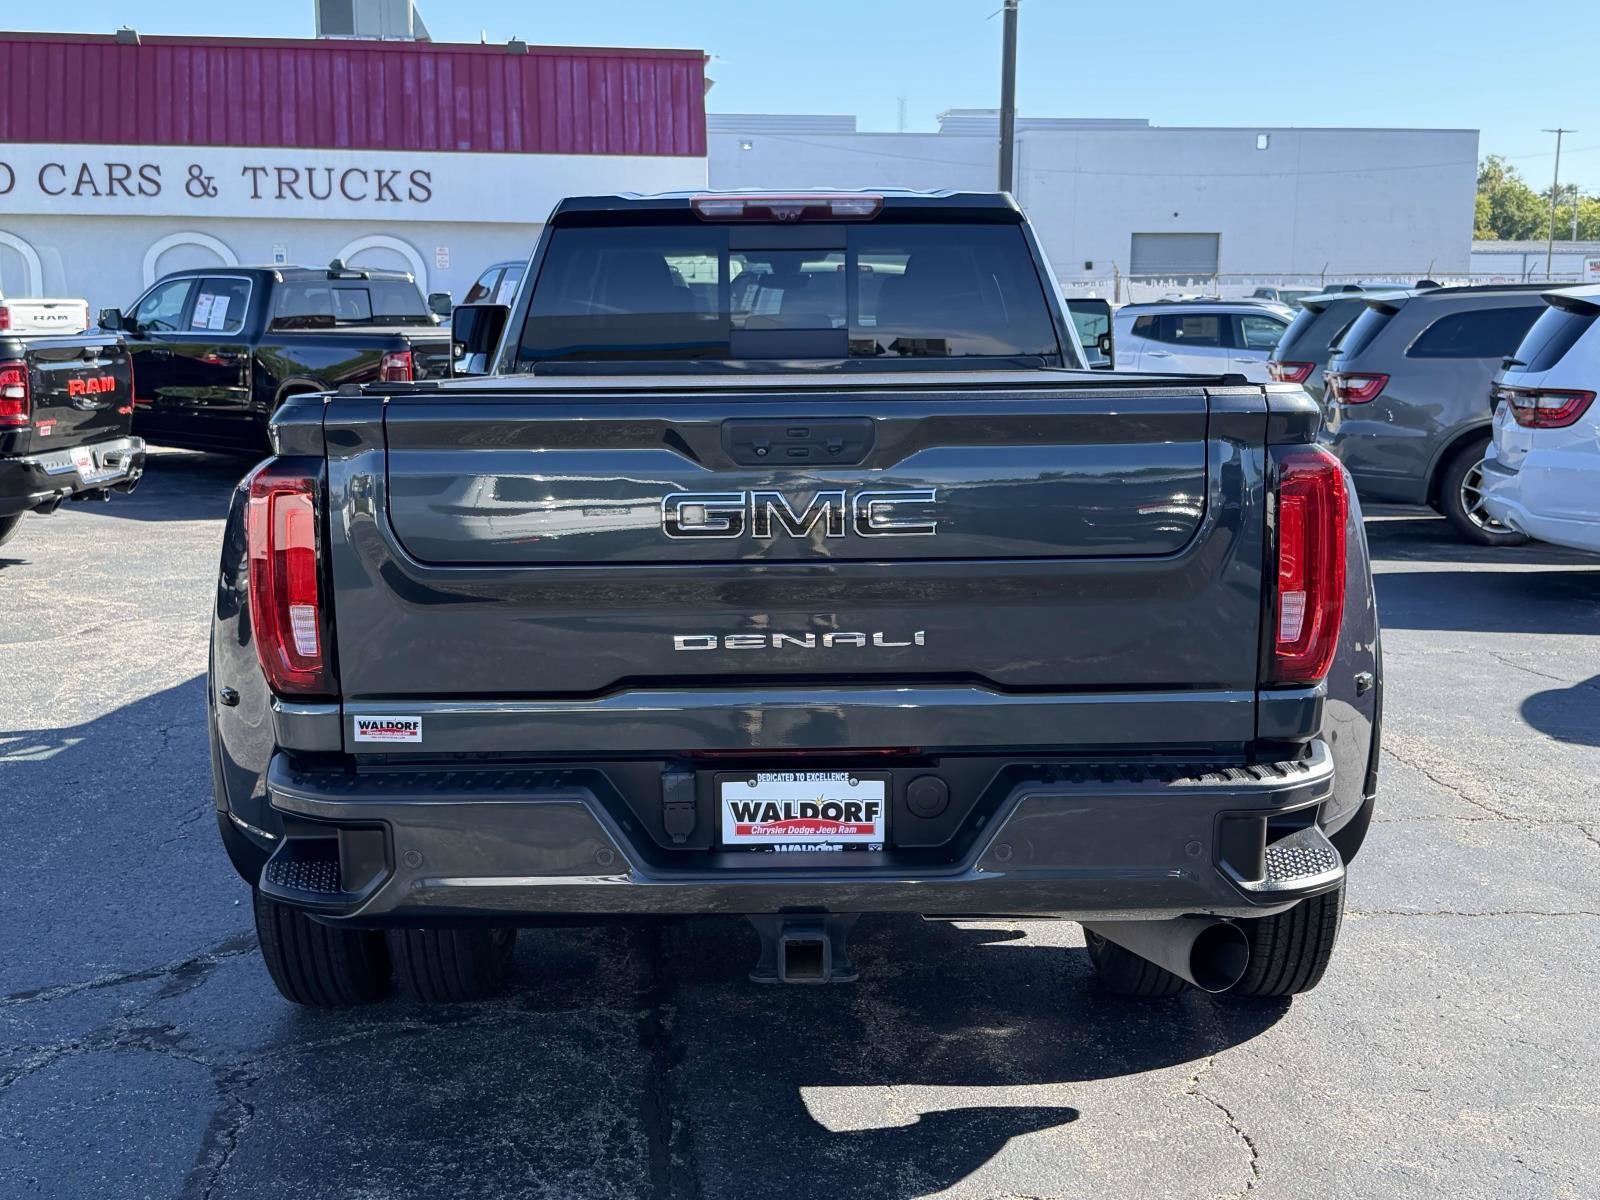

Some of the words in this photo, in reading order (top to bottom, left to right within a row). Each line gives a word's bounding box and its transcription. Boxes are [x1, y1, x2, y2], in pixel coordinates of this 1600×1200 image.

[39, 162, 162, 197] CARS
[185, 164, 218, 198] &
[241, 166, 432, 202] TRUCKS
[68, 376, 115, 396] RAM
[661, 488, 937, 539] GMC
[674, 630, 925, 650] DENALI
[359, 721, 419, 730] WALDORF
[757, 773, 794, 782] DEDICATED
[796, 773, 805, 782] TO
[806, 772, 850, 782] EXCELLENCE
[729, 801, 880, 823] WALDORF
[751, 825, 786, 835] Chrysler
[788, 825, 815, 835] Dodge
[816, 826, 837, 835] Jeep
[838, 826, 857, 834] Ram
